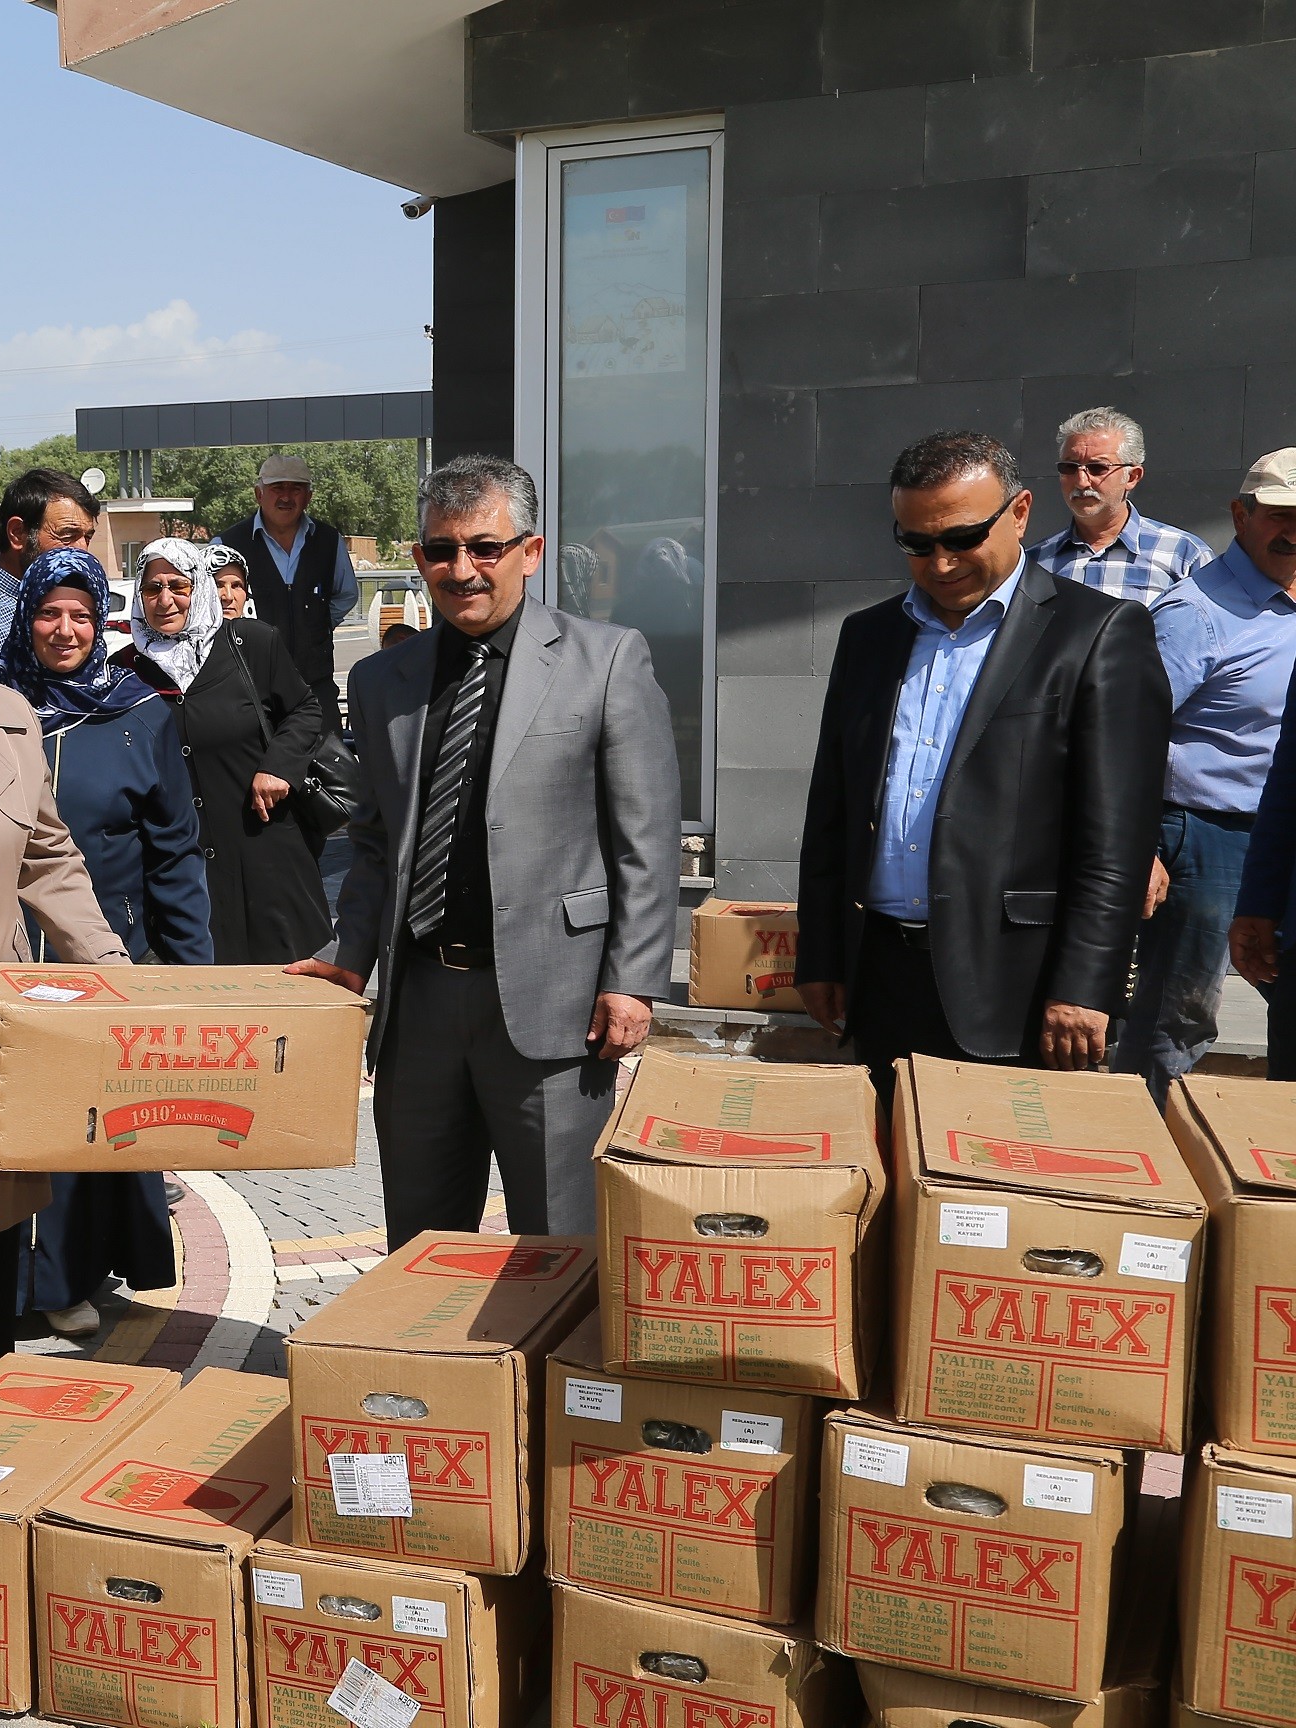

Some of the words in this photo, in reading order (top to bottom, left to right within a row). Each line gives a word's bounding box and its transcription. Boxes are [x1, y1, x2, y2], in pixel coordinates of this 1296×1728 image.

[129, 983, 241, 993] YALTIR
[105, 1076, 152, 1093] KALİTE
[156, 1076, 194, 1096] ÇİLEK
[198, 1074, 258, 1092] FİDELERİ
[176, 1113, 192, 1121] DAN
[194, 1113, 227, 1125] BUGÜNE
[938, 1353, 995, 1370] YALTIR
[1004, 1361, 1034, 1378] A.Ş.
[935, 1366, 949, 1375] P.K.
[951, 1368, 965, 1377] 151
[974, 1371, 999, 1383] ÇARŞI
[1006, 1375, 1035, 1386] ADANA
[1056, 1374, 1082, 1385] Çeşit
[933, 1376, 944, 1384] Tlf
[956, 1379, 976, 1390] (322)
[978, 1382, 993, 1391] 427
[995, 1384, 1005, 1392] 22
[1008, 1386, 1018, 1394] 10
[1019, 1388, 1035, 1397] pbx
[1055, 1388, 1084, 1398] Kalite
[932, 1386, 948, 1395] Fax
[955, 1389, 975, 1399] (322)
[978, 1392, 992, 1400] 427
[994, 1394, 1004, 1402] 22
[1280, 1390, 1296, 1399] 151
[1054, 1402, 1095, 1414] Sertifika
[1097, 1407, 1110, 1416] No
[1053, 1416, 1077, 1425] Kasa
[1080, 1419, 1093, 1427] No
[190, 1418, 262, 1467] YALTIR
[859, 1464, 883, 1472] KAYSERİ
[128, 1471, 184, 1510] YALEX
[1237, 1516, 1265, 1524] KAYSERİ
